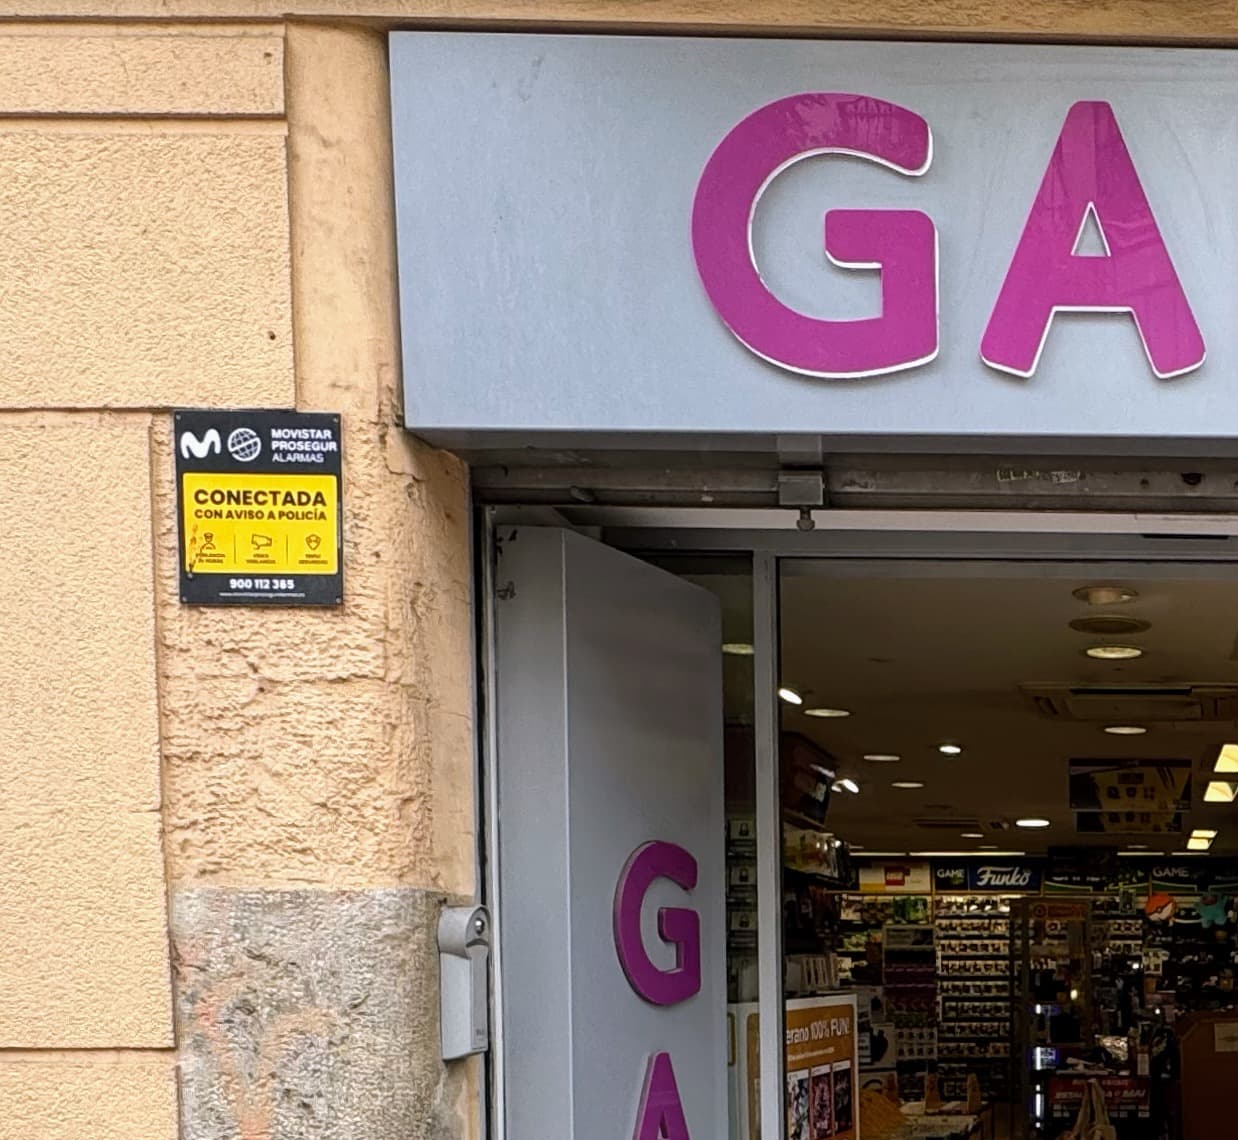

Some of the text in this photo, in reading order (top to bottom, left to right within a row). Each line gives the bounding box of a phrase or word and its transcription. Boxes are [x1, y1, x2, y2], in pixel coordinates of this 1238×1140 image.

[271, 428, 332, 440] MOVISTAR
[271, 440, 338, 452] PROSEGUR
[271, 452, 325, 463] ALARMAS
[194, 489, 327, 507] CONECTADA
[194, 508, 327, 521] CON AVISO A POLICÍA
[229, 578, 252, 590] 900
[254, 578, 270, 590] 112
[936, 868, 966, 880] GAME
[975, 865, 1033, 888] Funko
[1152, 865, 1191, 879] GAME
